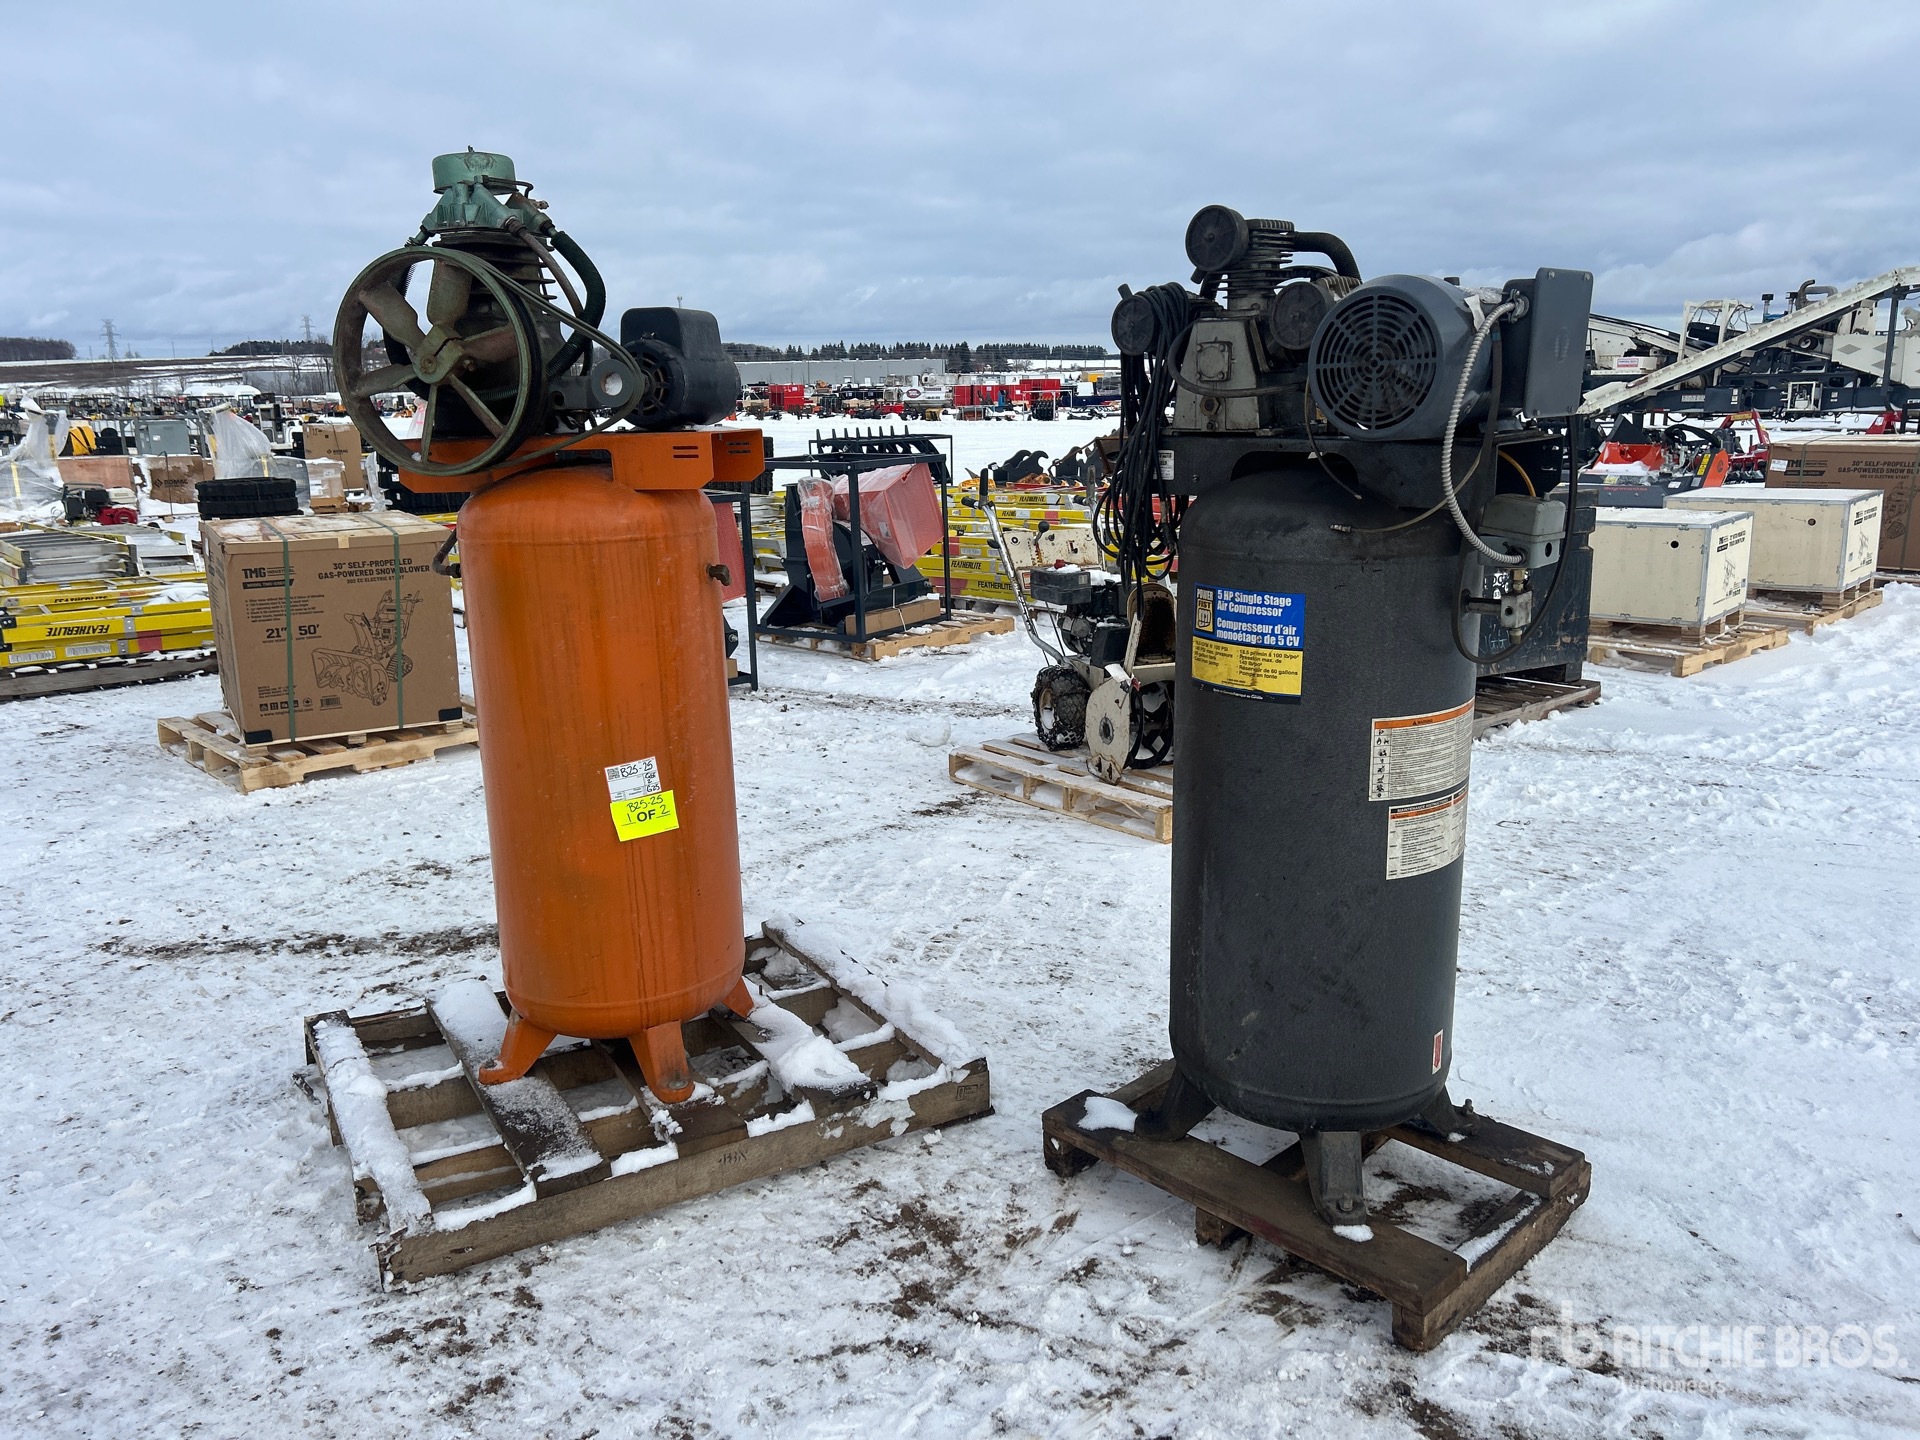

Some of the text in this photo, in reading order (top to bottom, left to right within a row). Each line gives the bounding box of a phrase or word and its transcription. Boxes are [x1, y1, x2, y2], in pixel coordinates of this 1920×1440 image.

[347, 558, 412, 569] SELF-PROPELED
[951, 560, 982, 570] FEATHERLITE
[242, 567, 266, 579] TMG
[318, 569, 374, 580] GAS-POWERED
[400, 565, 430, 574] BLOWER
[977, 581, 1013, 590] FEATHERLITE
[1197, 588, 1213, 600] POWER
[1217, 590, 1292, 607] 5 HP Single Stage
[1217, 601, 1283, 617] Air Compressor
[46, 625, 110, 637] FEATHERLITE
[298, 624, 319, 636] 50'
[1217, 617, 1296, 635] Compresseur d'air
[1216, 629, 1300, 646] monoétage de 5 CV
[627, 795, 664, 812] B25-25
[637, 809, 656, 822] OF
[660, 805, 670, 815] 2
